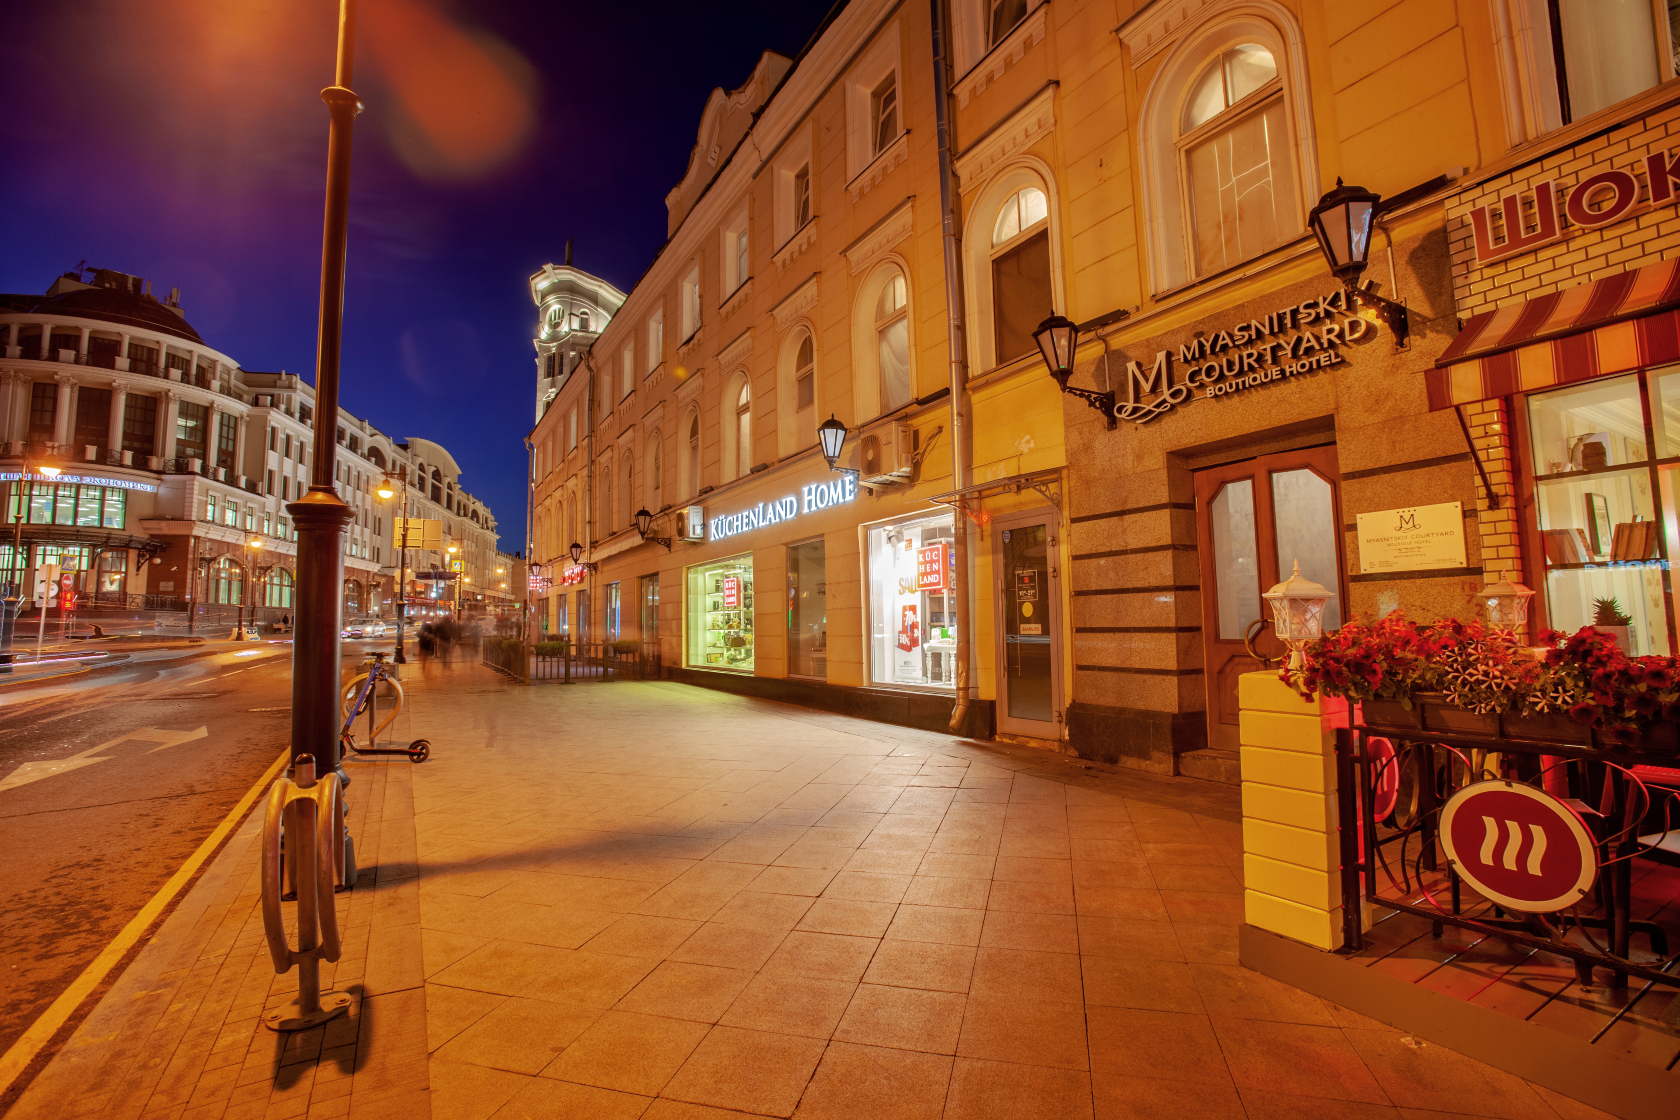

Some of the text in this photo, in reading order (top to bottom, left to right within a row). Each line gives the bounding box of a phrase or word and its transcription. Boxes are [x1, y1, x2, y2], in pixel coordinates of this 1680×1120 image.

[1185, 316, 1368, 387] COURTYARD
[1206, 350, 1341, 398] BOUTIQUE HOTEL
[82, 476, 157, 493] ЭКОНОМИКИ
[710, 475, 855, 541] KÜCHENLAND HOME
[1366, 530, 1455, 544] MYASNITSKIY COURTYARD
[919, 562, 939, 573] HEN
[919, 574, 939, 585] LAND
[1474, 602, 1485, 617] 2
